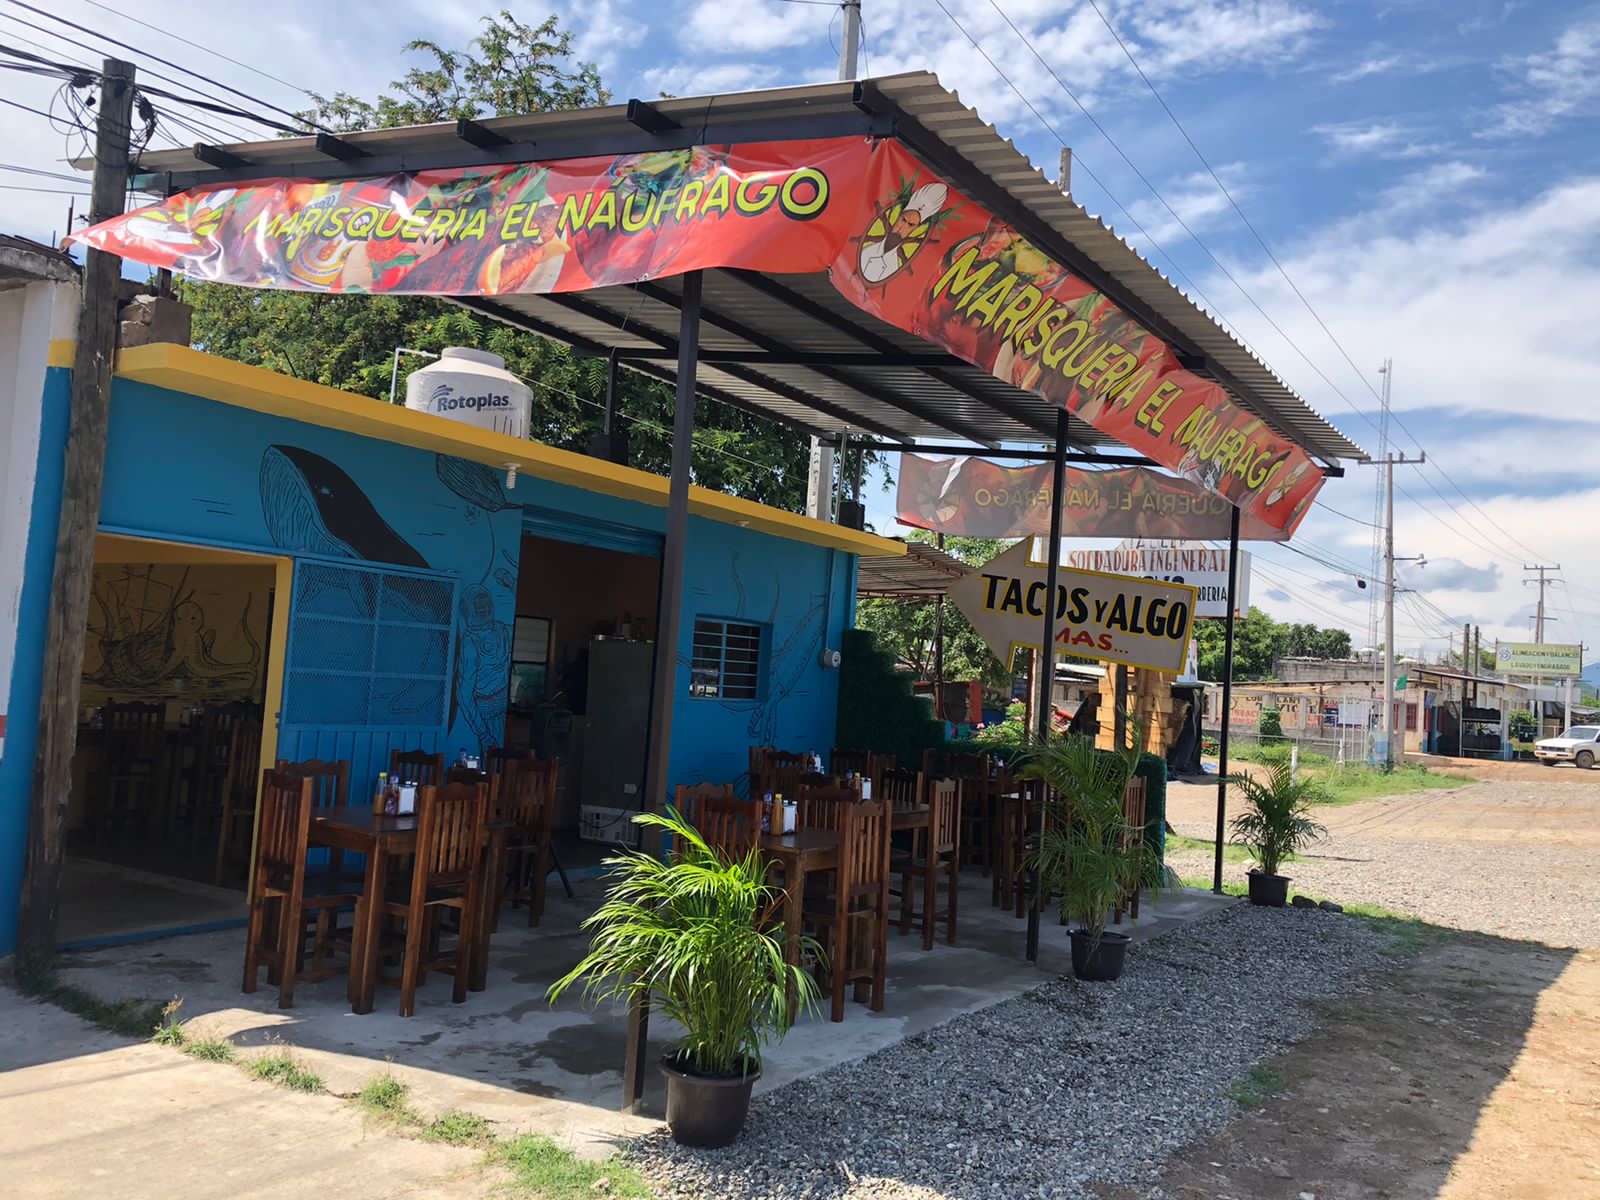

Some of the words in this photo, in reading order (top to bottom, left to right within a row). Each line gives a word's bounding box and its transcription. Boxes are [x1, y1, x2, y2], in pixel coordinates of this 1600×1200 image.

[500, 200, 543, 242] EL
[557, 167, 829, 238] NÁUFRAGO
[437, 393, 510, 412] Rotoplas
[1135, 379, 1185, 438] EL
[981, 573, 1090, 625] TACOS
[1093, 599, 1109, 623] Y
[1106, 593, 1188, 640] ALGO
